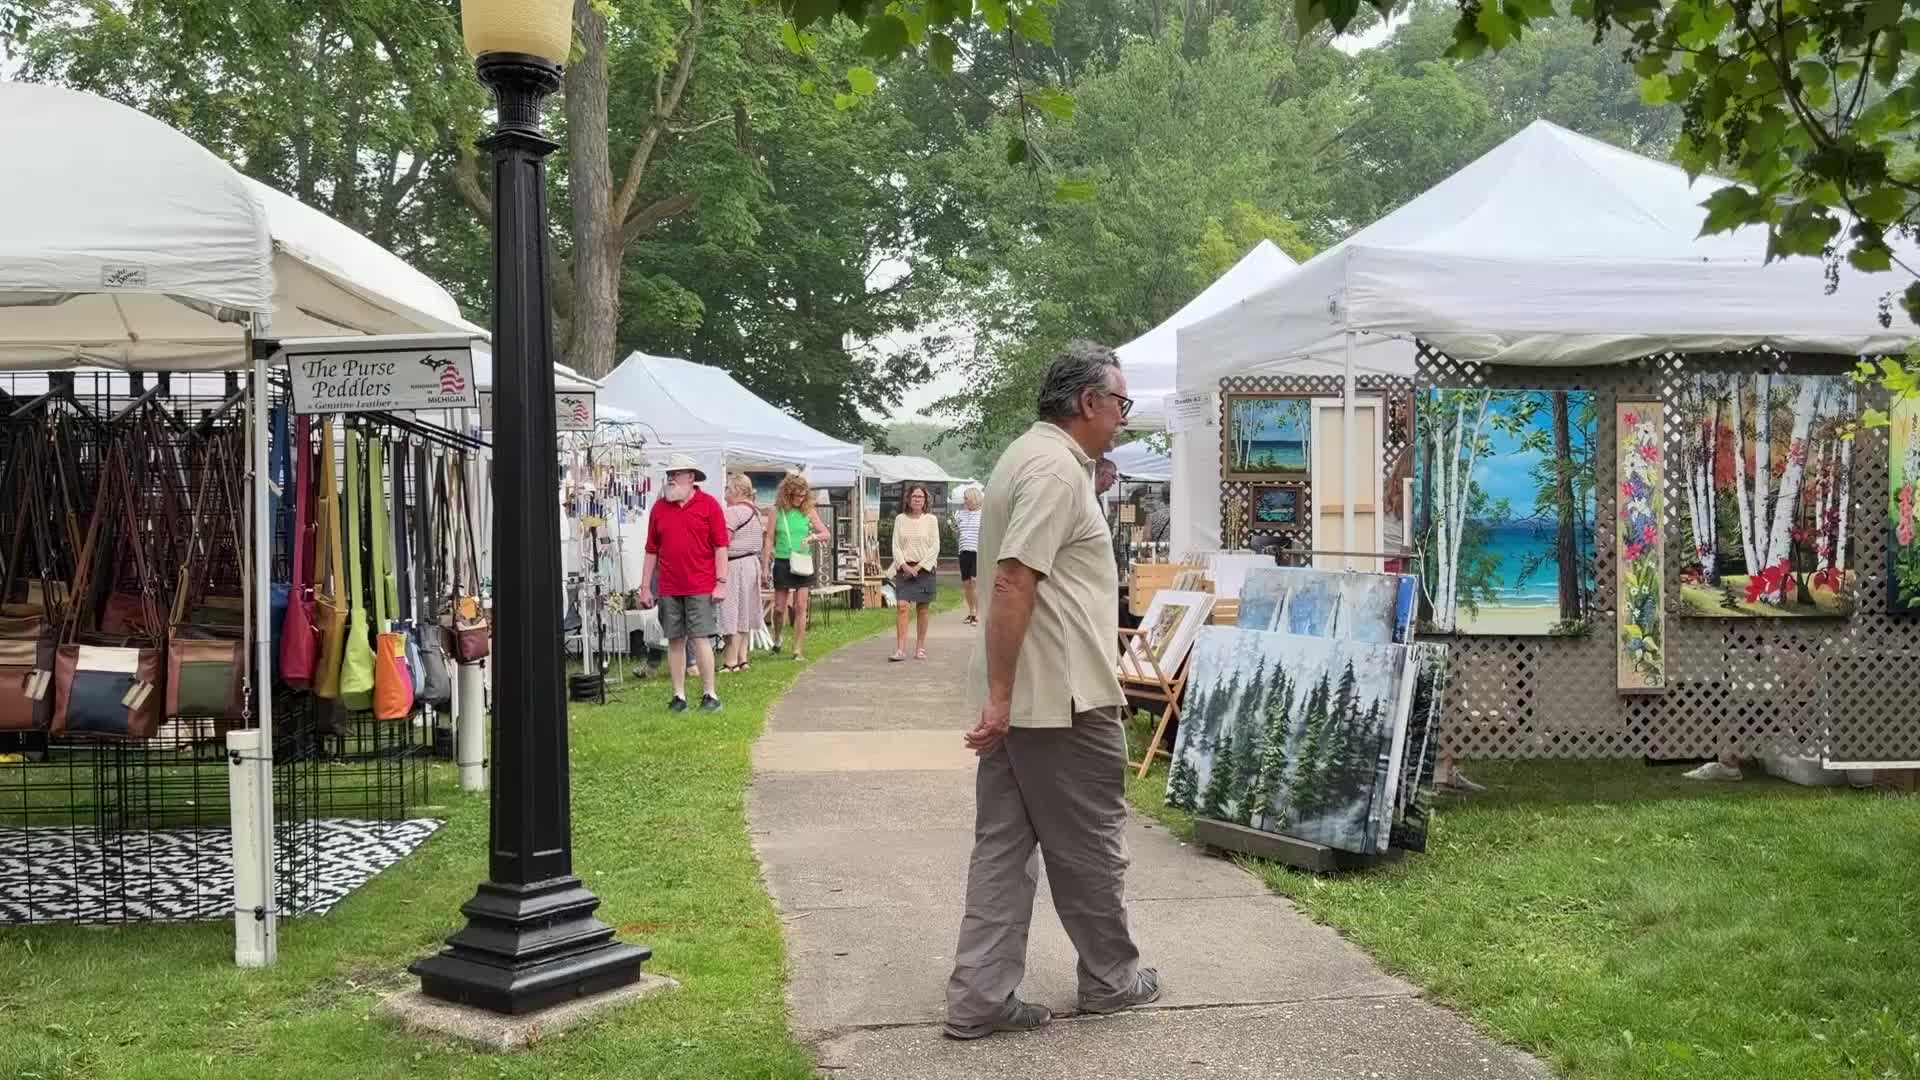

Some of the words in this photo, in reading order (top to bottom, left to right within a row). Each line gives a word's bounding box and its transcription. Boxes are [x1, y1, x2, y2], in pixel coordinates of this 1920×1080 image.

[302, 358, 337, 378] The
[343, 359, 396, 377] Purse
[312, 377, 391, 398] Peddlers
[356, 399, 392, 409] Leather
